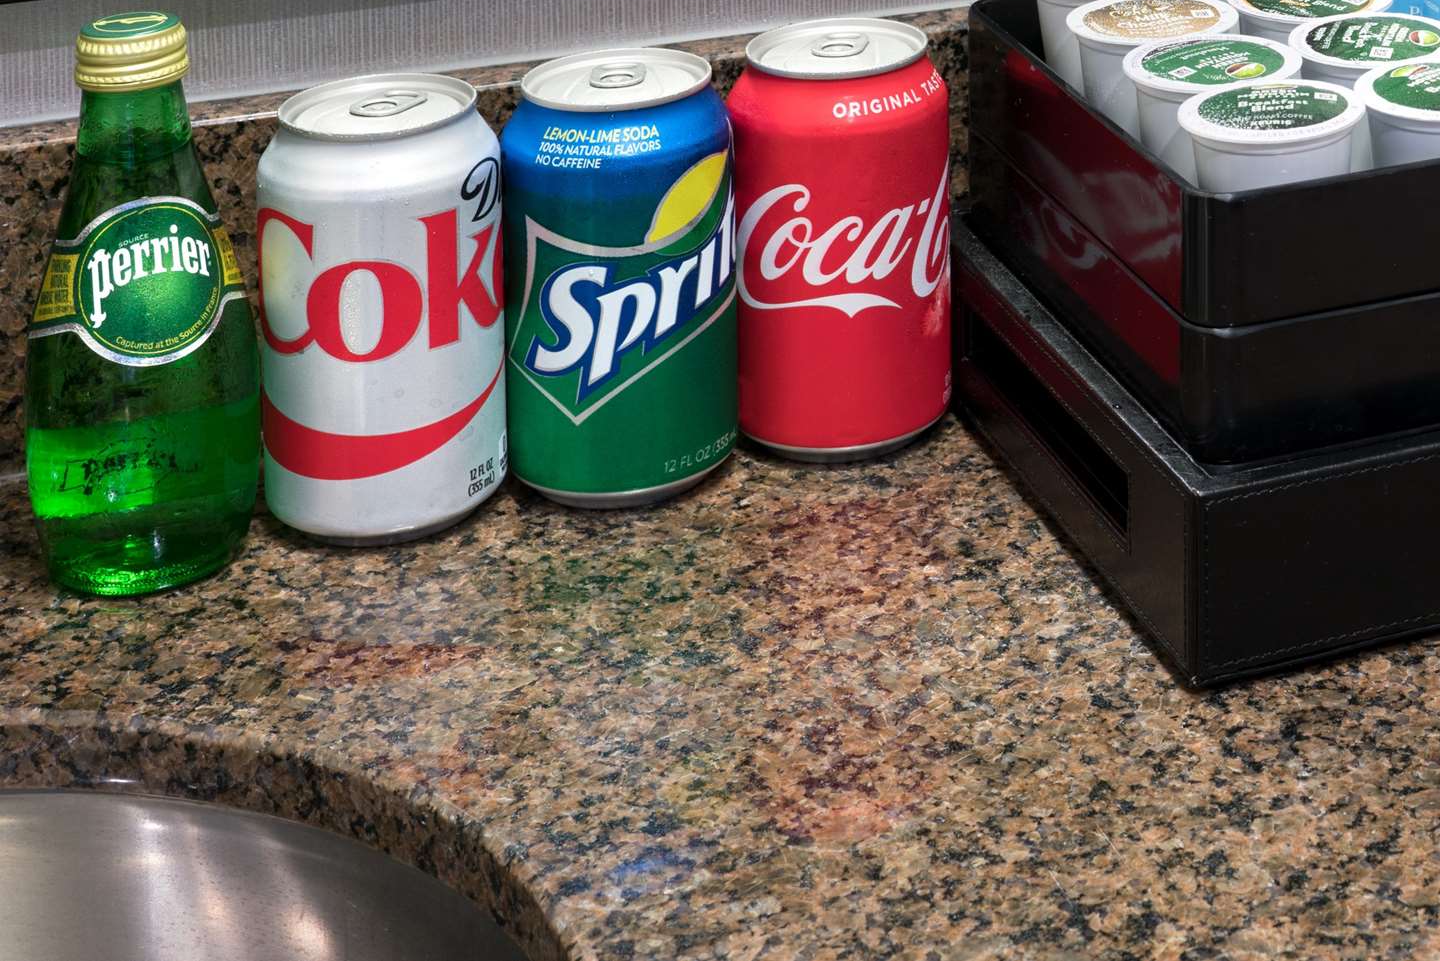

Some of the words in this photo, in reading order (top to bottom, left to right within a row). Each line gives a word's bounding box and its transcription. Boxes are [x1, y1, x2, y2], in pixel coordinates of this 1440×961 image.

[832, 89, 922, 119] ORIGINAL
[543, 126, 621, 144] LEMON-LIME
[622, 124, 660, 141] SODA
[539, 142, 564, 155] 100%
[564, 144, 613, 157] NATURAL
[613, 140, 662, 156] FLAVORS
[536, 154, 551, 166] NO
[552, 156, 602, 169] CAFFEINE
[118, 233, 150, 248] SOURCE
[532, 176, 736, 388] Sprit
[115, 336, 154, 350] Captured
[155, 339, 164, 349] at
[164, 336, 180, 347] the
[179, 319, 203, 340] Source
[201, 312, 209, 322] in
[469, 466, 478, 480] 12
[478, 463, 486, 476] FL
[486, 457, 495, 471] OZ
[664, 458, 676, 474] 12
[680, 455, 692, 468] FL
[695, 447, 710, 462] OZ
[468, 478, 484, 497] (355
